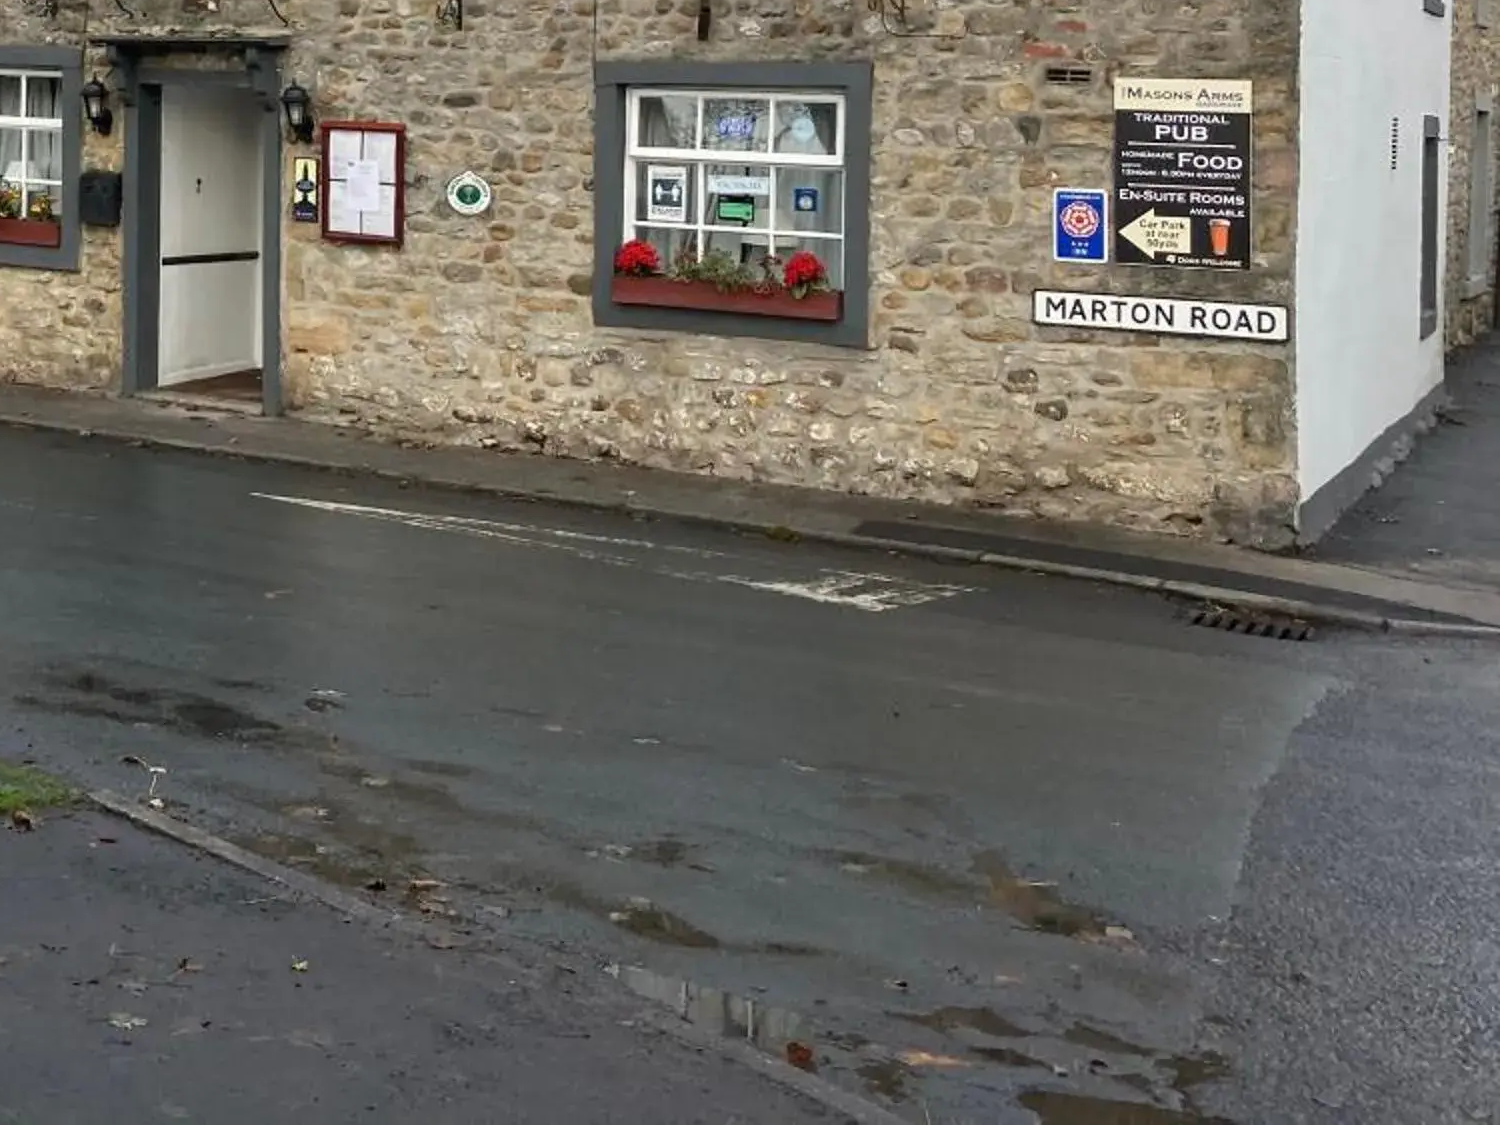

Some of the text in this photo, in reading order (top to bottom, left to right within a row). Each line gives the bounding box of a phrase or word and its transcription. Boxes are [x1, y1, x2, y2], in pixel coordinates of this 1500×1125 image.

[1127, 87, 1193, 100] MASONS
[1197, 88, 1243, 101] ARMS
[1133, 112, 1230, 125] TRADITIONAL
[1155, 124, 1209, 142] PUB
[1177, 152, 1243, 170] FOOD
[1119, 188, 1245, 206] EN-SUITE ROOMS
[1189, 207, 1245, 218] AVAILABLE
[1139, 219, 1185, 229] Car Park
[1145, 230, 1180, 239] at rear
[1045, 296, 1277, 334] MARTON ROAD
